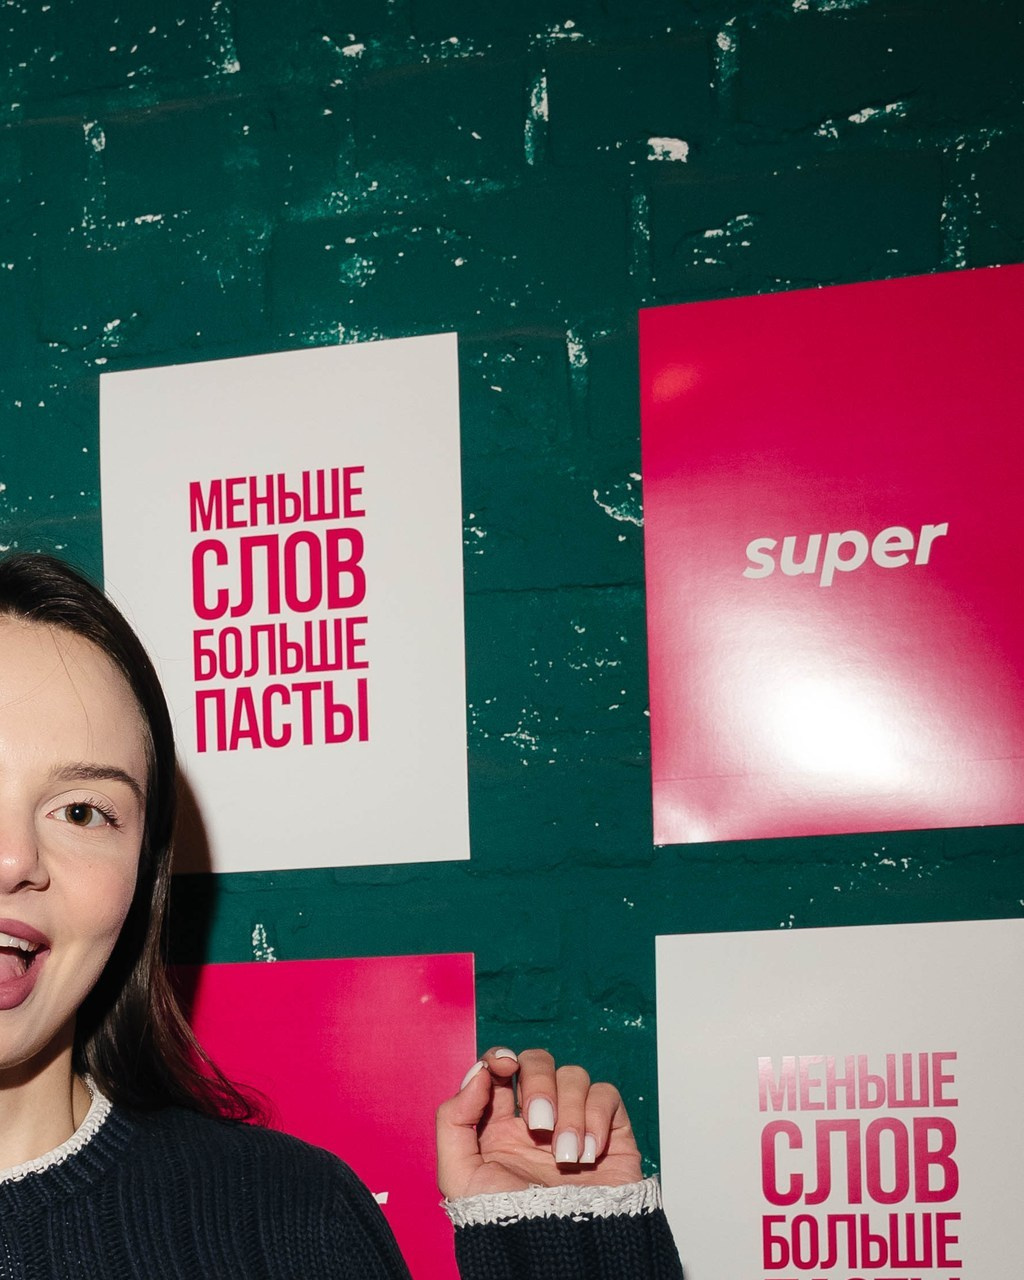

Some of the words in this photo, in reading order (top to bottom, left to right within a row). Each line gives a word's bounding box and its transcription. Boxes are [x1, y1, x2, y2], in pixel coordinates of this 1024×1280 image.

[188, 464, 367, 533] МЕНЬШЕ
[191, 526, 368, 622] СЛОВ
[742, 522, 949, 587] super
[192, 615, 370, 683] БОЛЬШЕ
[194, 677, 370, 754] ПАСТЫ
[758, 1051, 960, 1112] МЕНЬШЕ
[760, 1115, 960, 1208] СЛОВ
[761, 1211, 964, 1271] БОЛЬШЕ
